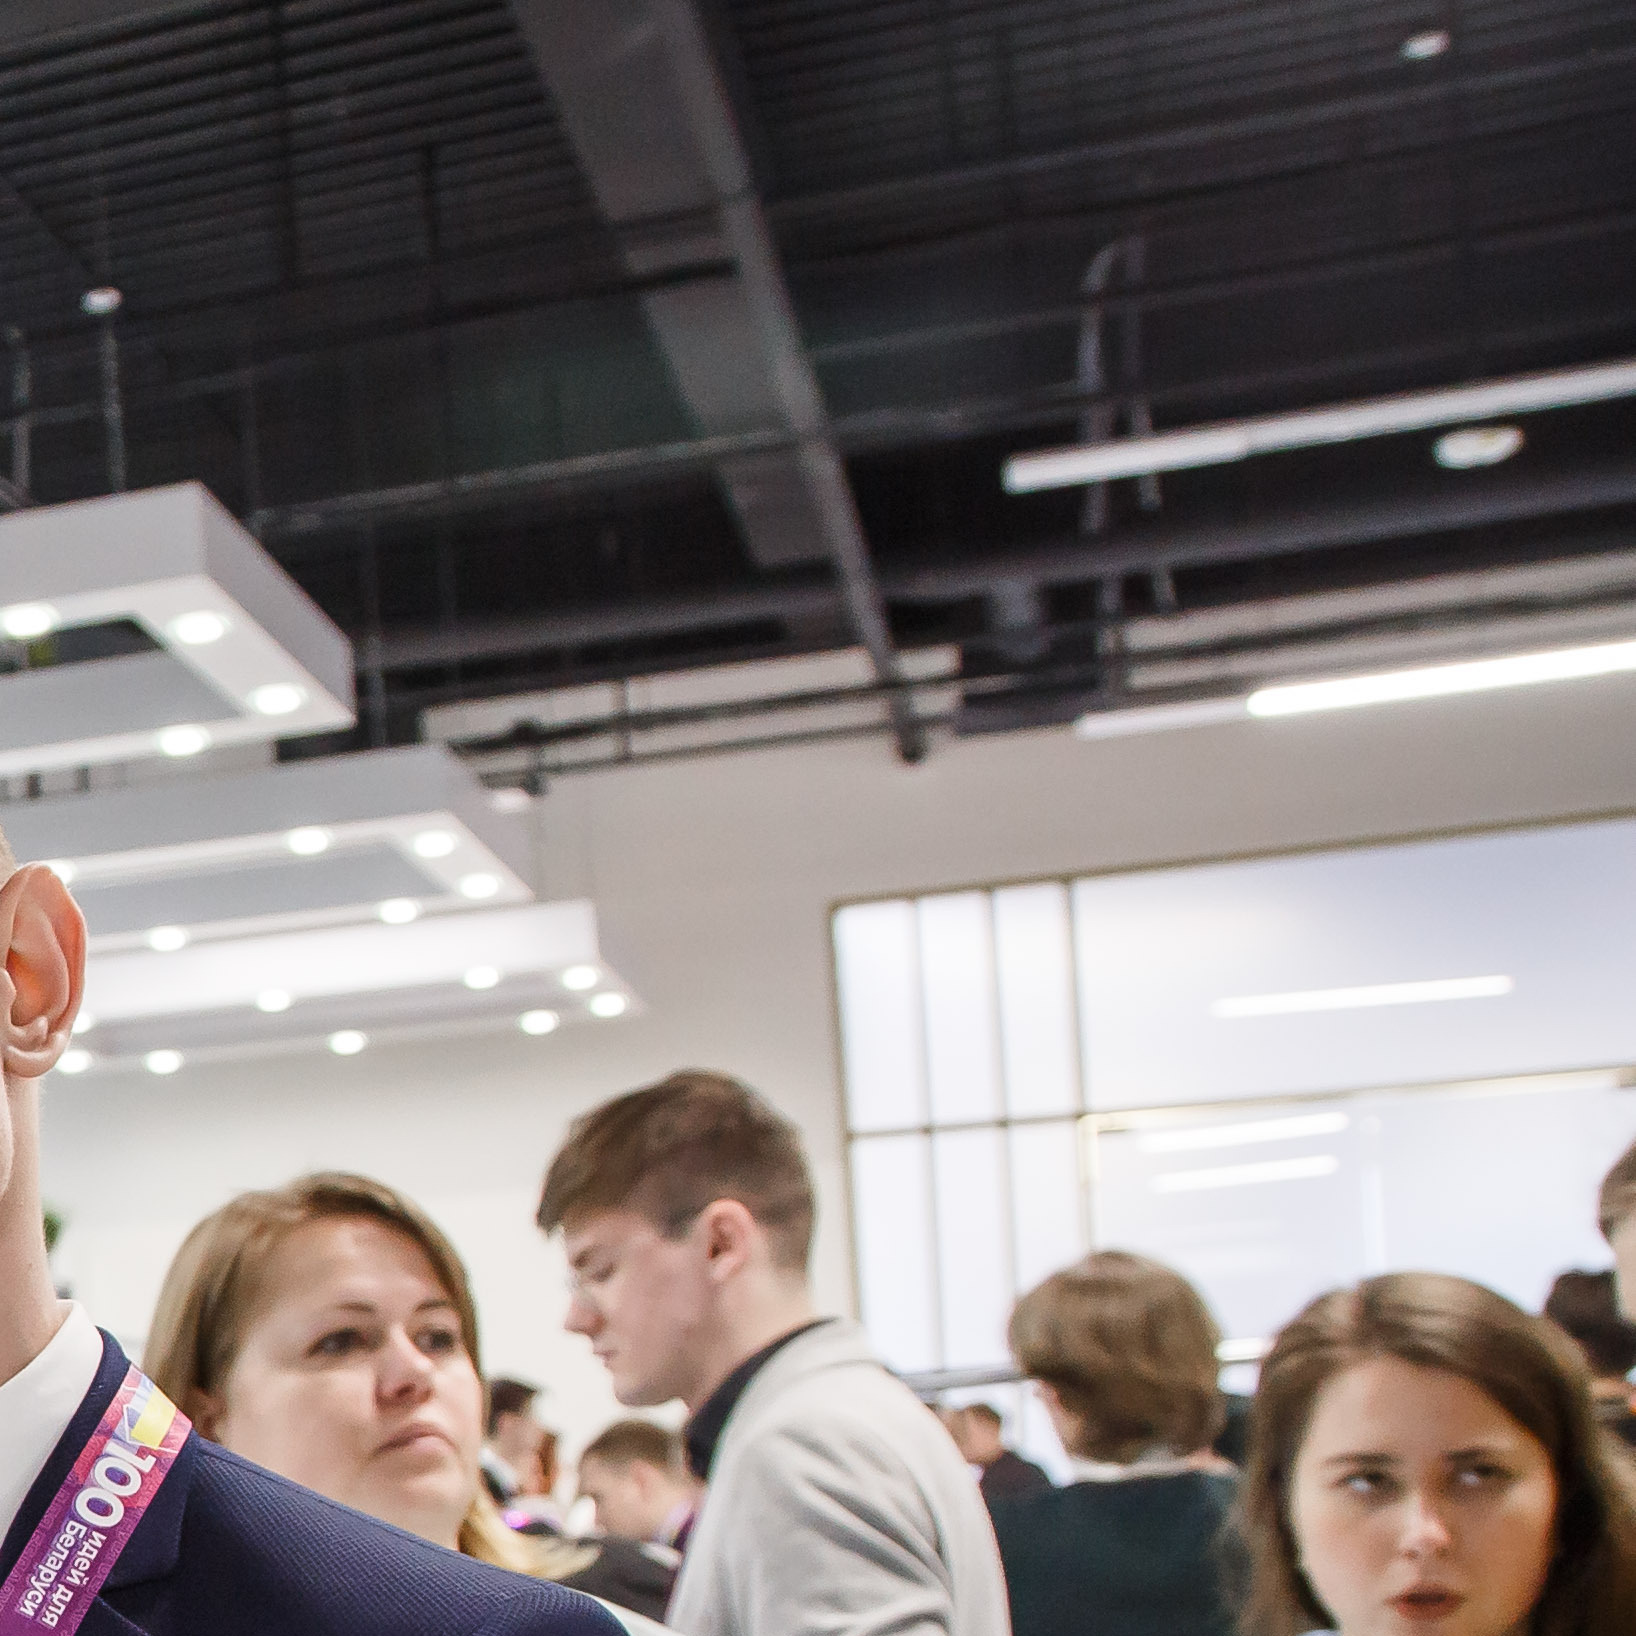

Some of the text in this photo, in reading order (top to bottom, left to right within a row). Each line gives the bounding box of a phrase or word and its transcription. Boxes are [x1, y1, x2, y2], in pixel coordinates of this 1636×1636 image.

[75, 1443, 158, 1528] 100
[19, 1519, 88, 1617] Беларуси
[41, 1528, 108, 1628] идей для
